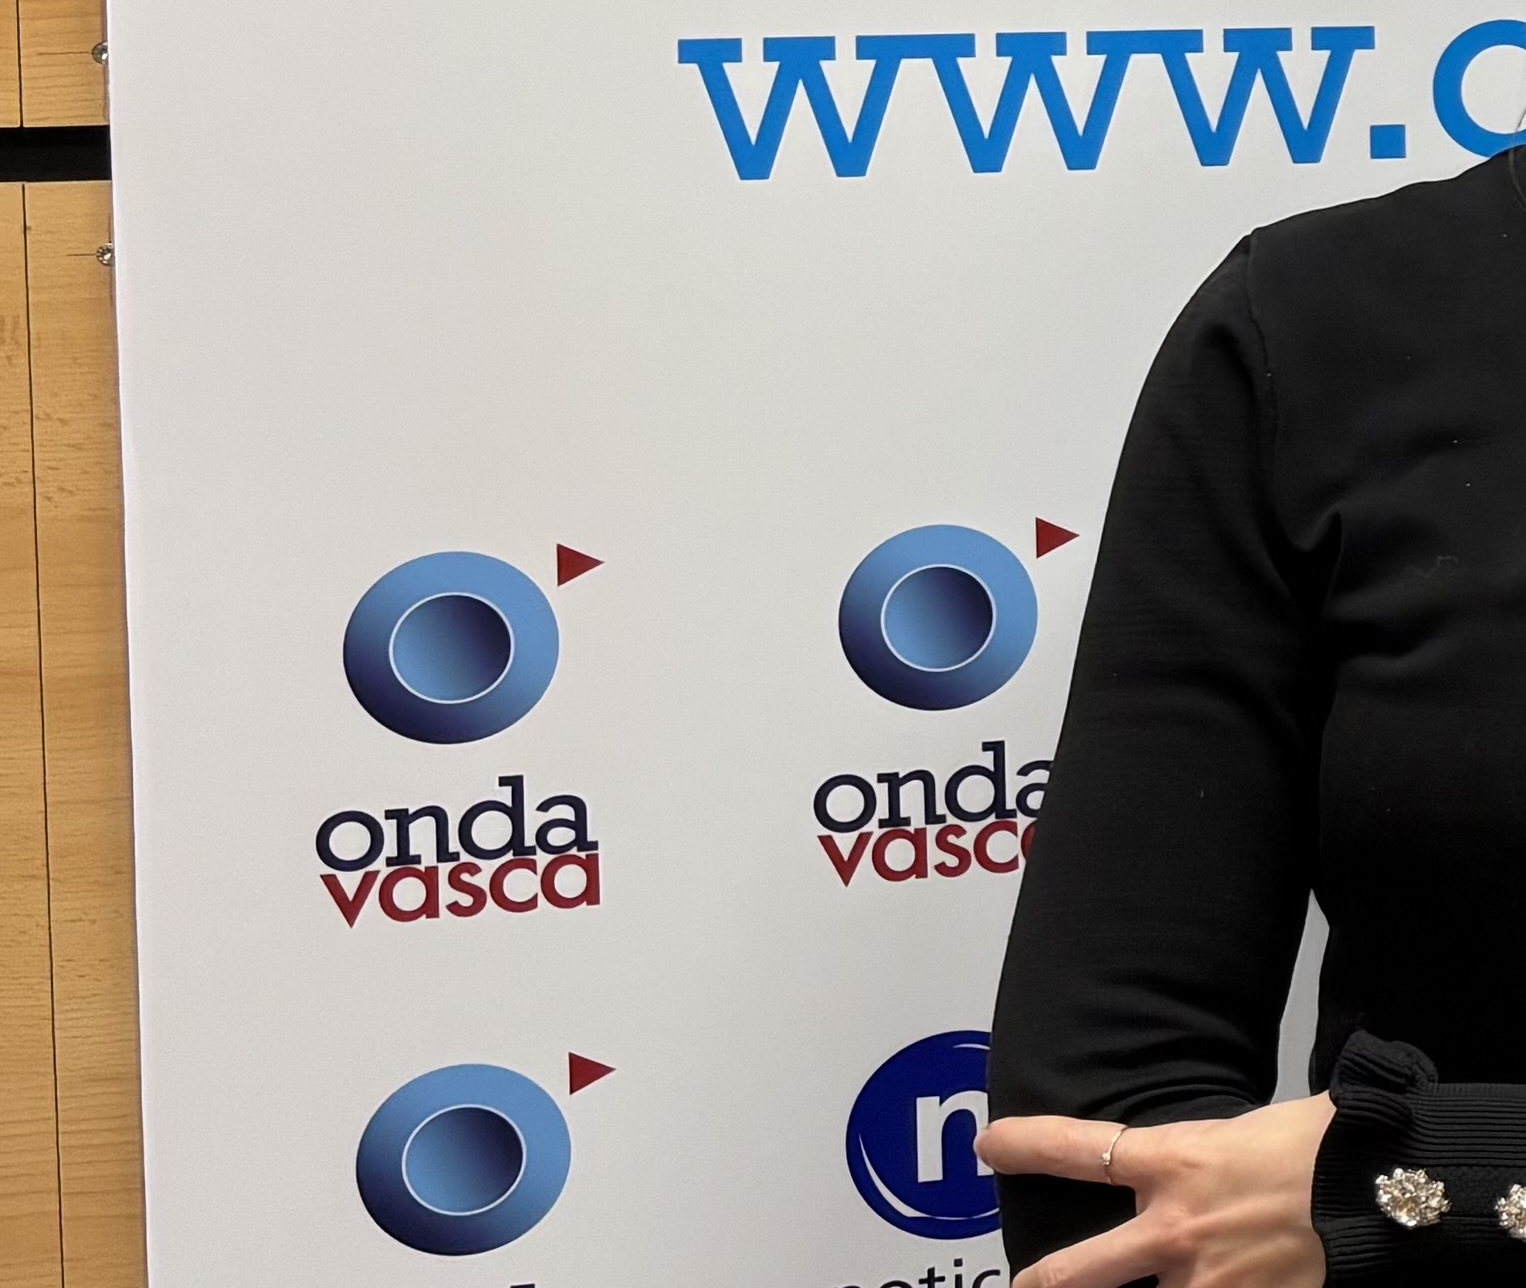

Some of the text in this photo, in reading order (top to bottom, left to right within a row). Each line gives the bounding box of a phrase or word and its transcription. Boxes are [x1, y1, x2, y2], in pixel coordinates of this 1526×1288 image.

[316, 775, 598, 872] onda
[817, 819, 1035, 888] vasc
[320, 853, 600, 929] vasca
[916, 1090, 995, 1183] n
